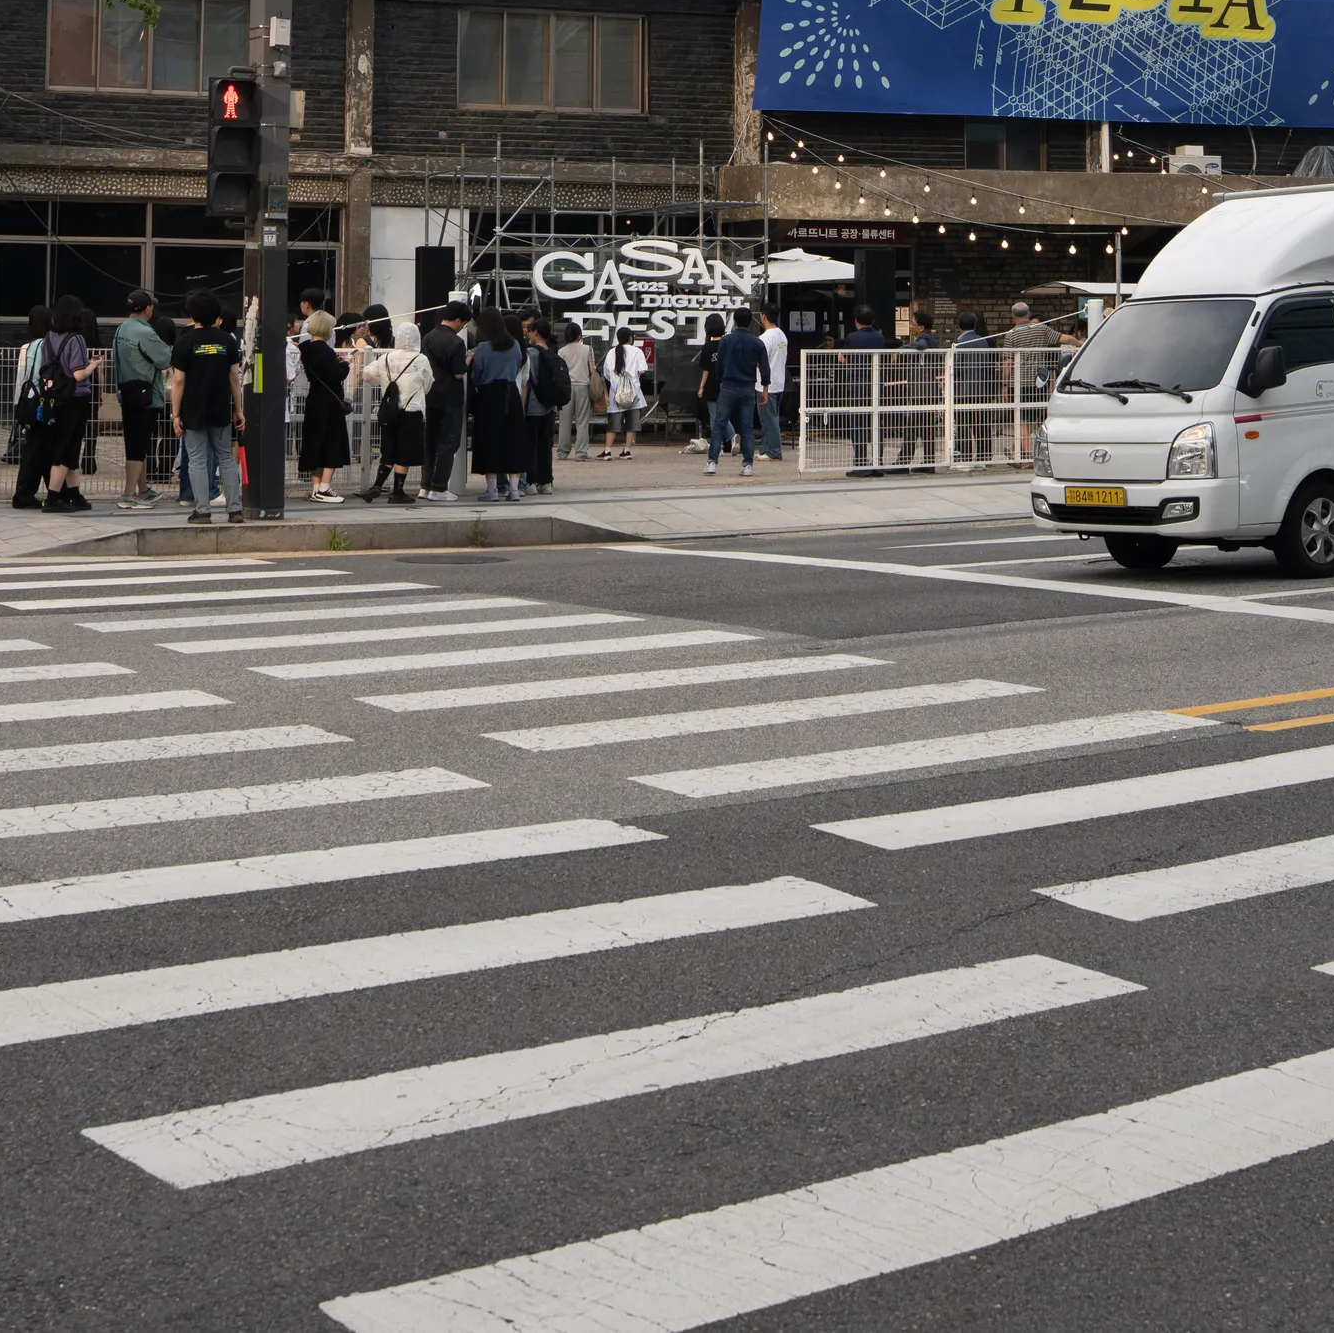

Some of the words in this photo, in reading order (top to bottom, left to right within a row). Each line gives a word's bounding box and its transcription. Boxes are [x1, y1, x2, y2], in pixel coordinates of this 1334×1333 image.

[532, 240, 758, 306] GASAN
[627, 281, 668, 292] 2025
[640, 294, 750, 309] DIGITAL
[563, 309, 734, 347] FEST
[1096, 491, 1119, 503] 1211
